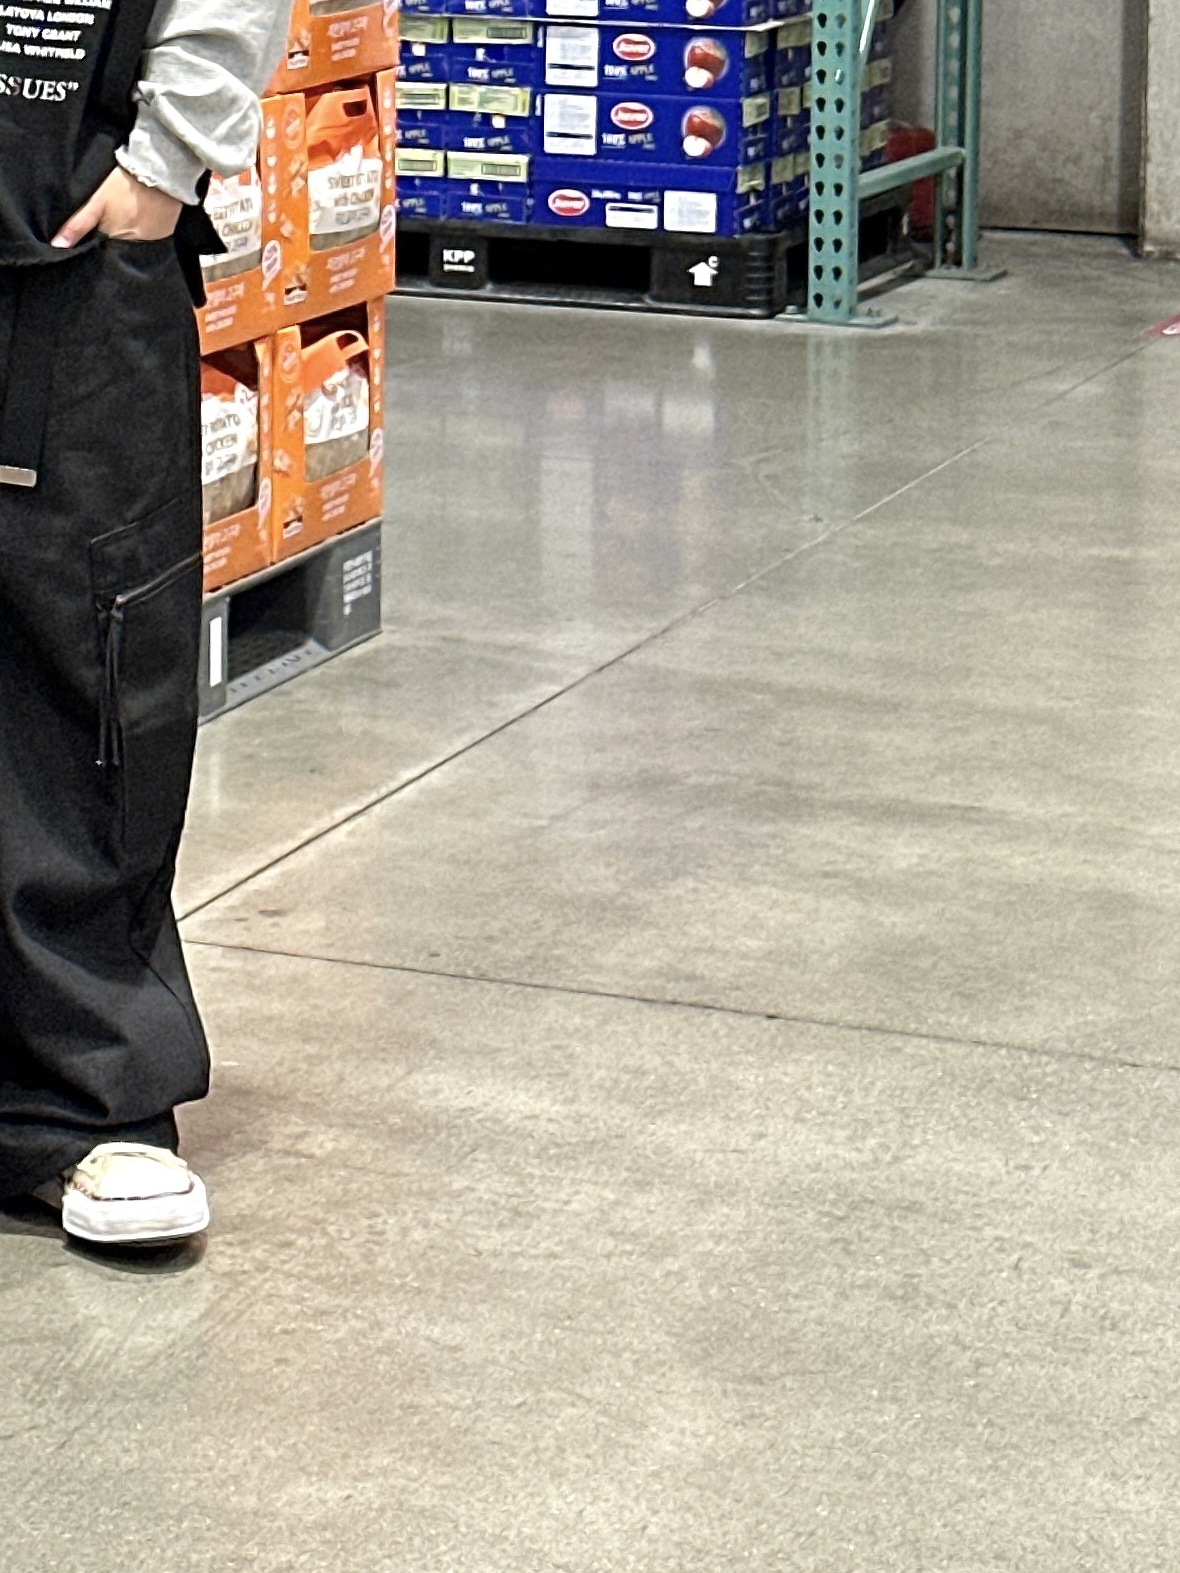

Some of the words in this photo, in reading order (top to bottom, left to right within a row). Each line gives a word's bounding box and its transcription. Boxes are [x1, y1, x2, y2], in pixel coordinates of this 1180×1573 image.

[5, 23, 41, 39] TONY
[41, 28, 83, 42] GRANT
[443, 249, 475, 264] KPP
[708, 256, 719, 268] C
